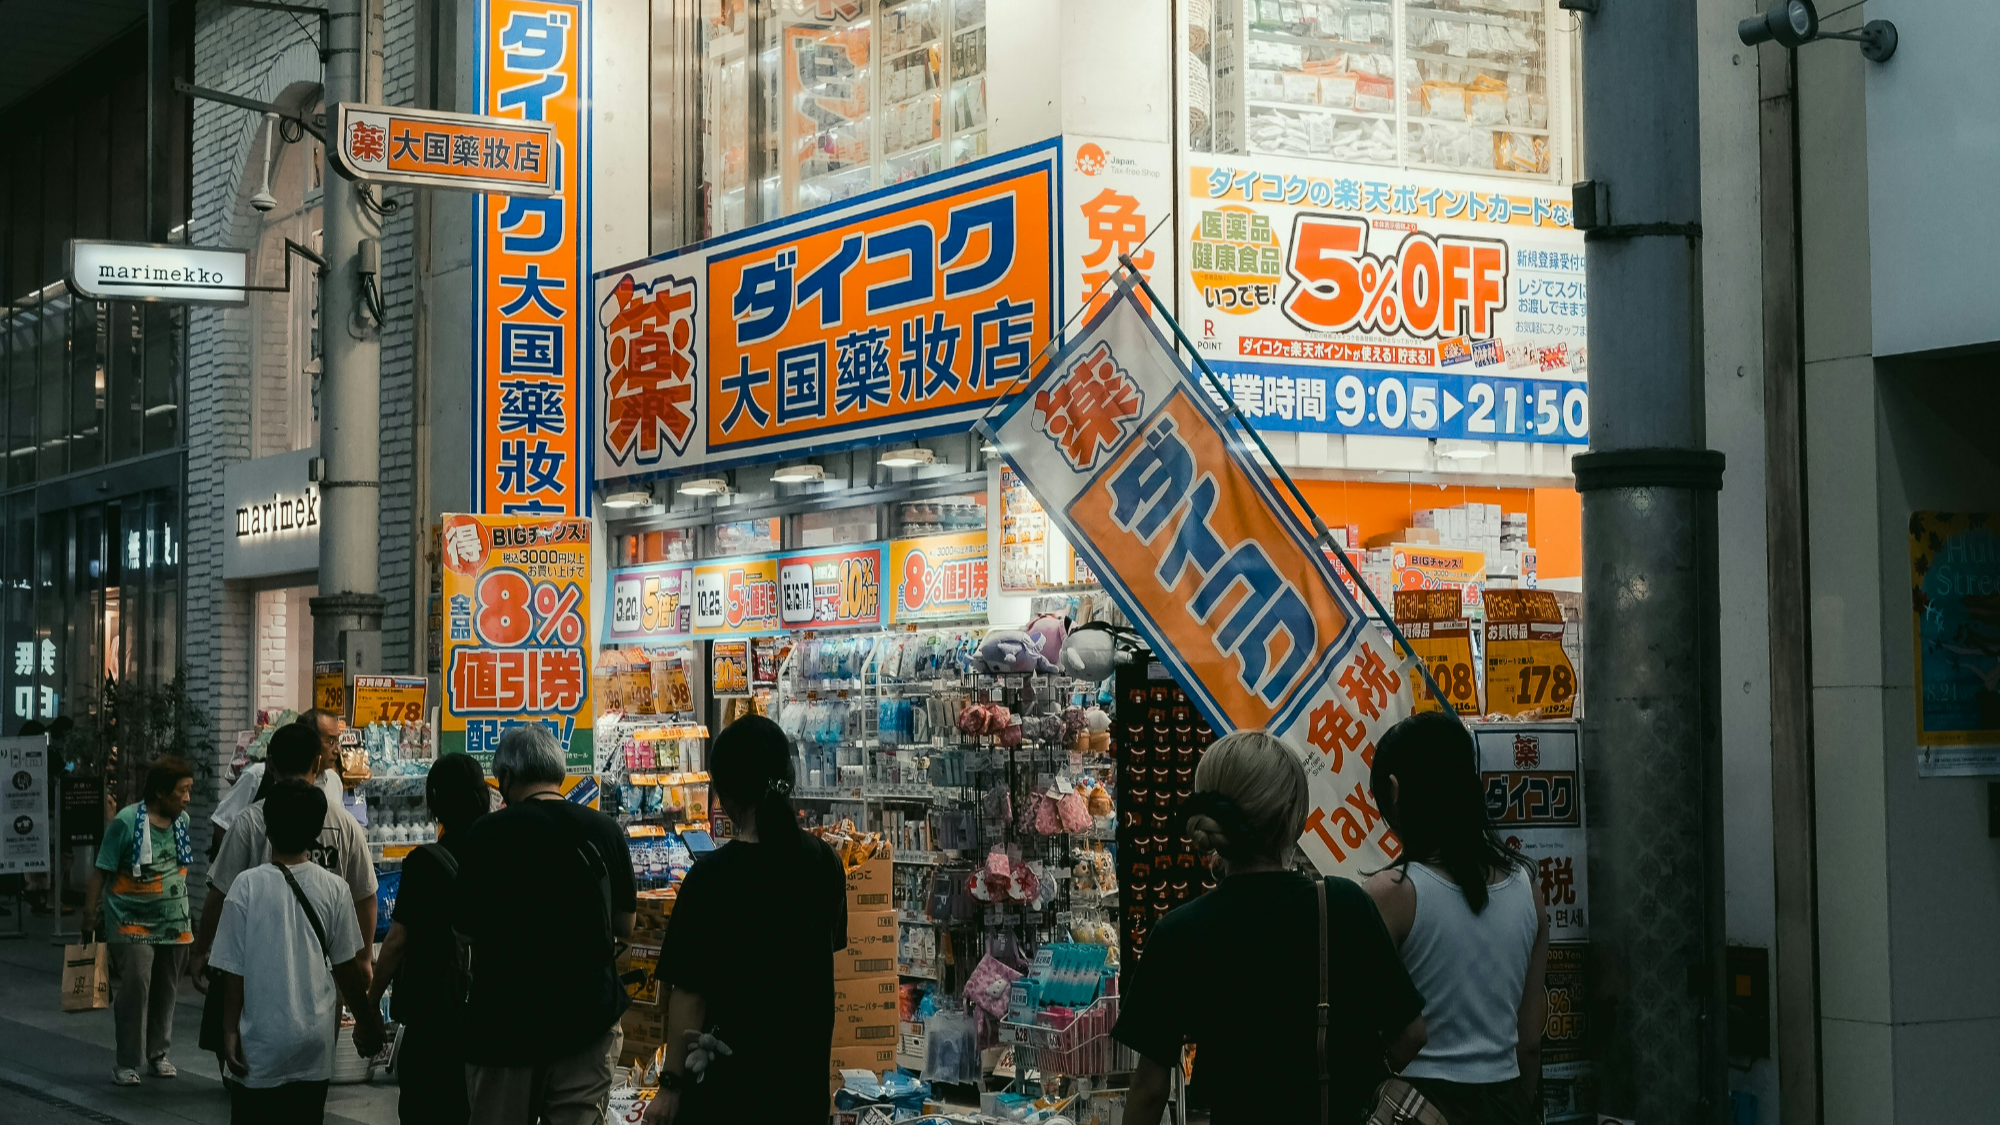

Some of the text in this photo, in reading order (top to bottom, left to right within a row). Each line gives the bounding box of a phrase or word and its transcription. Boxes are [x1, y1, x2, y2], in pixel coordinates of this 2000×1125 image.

[392, 129, 540, 173] 大国藥妝店
[1206, 167, 1574, 226] ダイコクの楽天ポイントカードな
[1201, 211, 1272, 244] 医薬品
[99, 263, 223, 284] marimekko
[499, 10, 567, 517] ダイク大国藥妝
[733, 191, 1014, 346] ダイコク
[1192, 243, 1281, 277] 健康食品
[1287, 220, 1502, 339] 5%OFF
[1197, 341, 1222, 350] POINT
[720, 297, 1037, 435] 大国藥妝店
[1199, 370, 1327, 423] 営業時間
[1334, 374, 1438, 432] 9:05
[236, 487, 318, 537] marimek
[445, 523, 482, 566] 得
[503, 549, 585, 569] 税込3000円以上
[1107, 412, 1320, 708] ダイコク
[527, 565, 585, 579] お買い上げで
[1936, 565, 2000, 597] Stree
[450, 593, 471, 640] 全品
[479, 571, 583, 646] 8%
[1487, 623, 1528, 640] お買得品
[325, 687, 343, 707] 298
[453, 649, 583, 711] 値引券
[1516, 665, 1573, 704] 178
[377, 701, 422, 722] 178
[466, 715, 575, 752] 配!
[1486, 776, 1576, 821] ダイコク
[1555, 910, 1584, 929] 면세
[1015, 1024, 1028, 1042] 628
[1548, 1014, 1585, 1039] OFF
